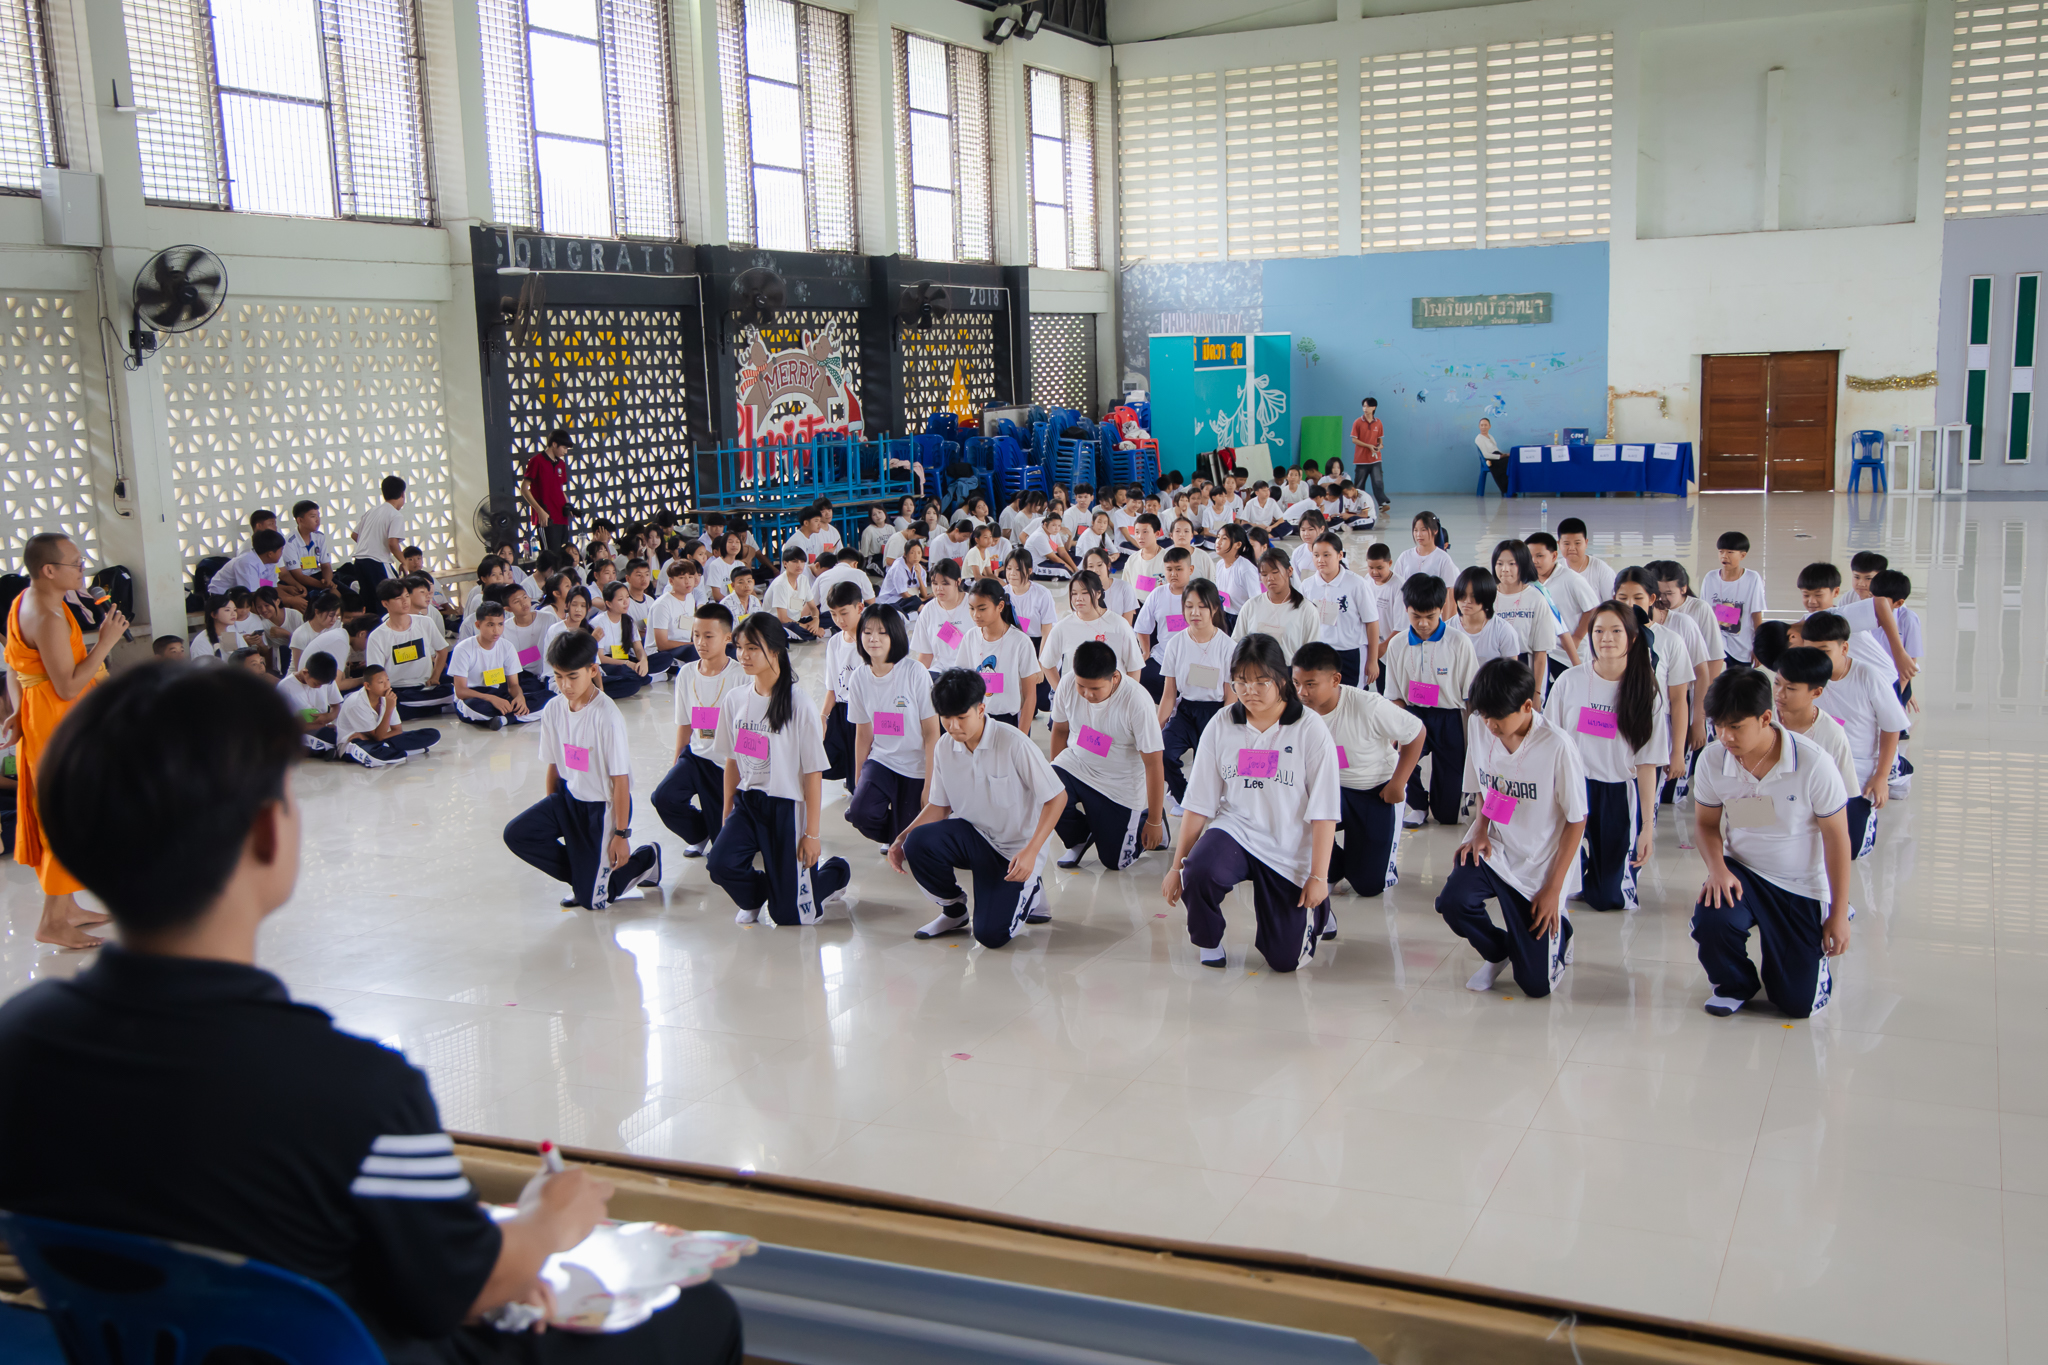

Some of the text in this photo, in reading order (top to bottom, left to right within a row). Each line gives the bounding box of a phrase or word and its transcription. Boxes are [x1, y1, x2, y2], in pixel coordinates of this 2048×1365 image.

[970, 288, 999, 306] 2018
[763, 359, 820, 398] MERRY
[1244, 778, 1264, 789] Lee
